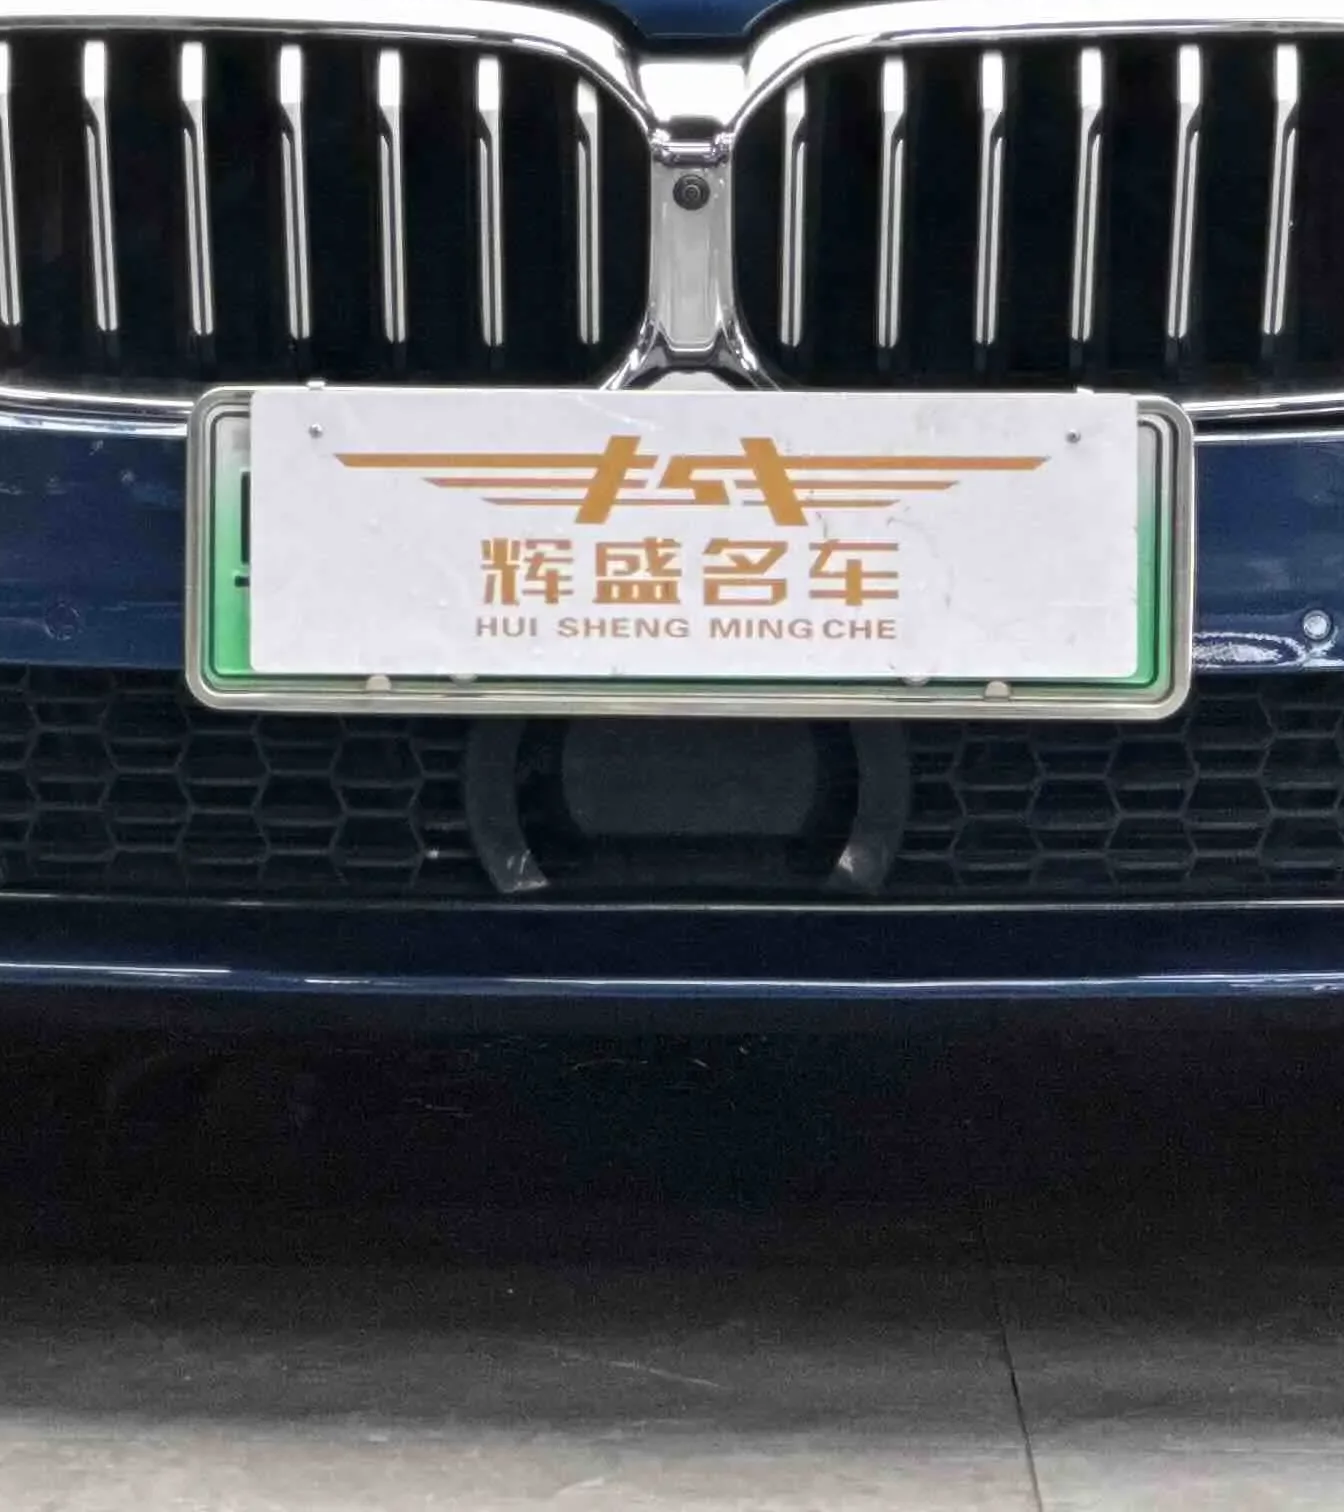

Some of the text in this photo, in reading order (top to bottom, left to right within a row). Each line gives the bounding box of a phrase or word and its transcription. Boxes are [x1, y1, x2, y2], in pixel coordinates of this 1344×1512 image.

[480, 536, 900, 607] 辉盛名车
[475, 616, 539, 638] HUI
[556, 616, 691, 639] SHENG
